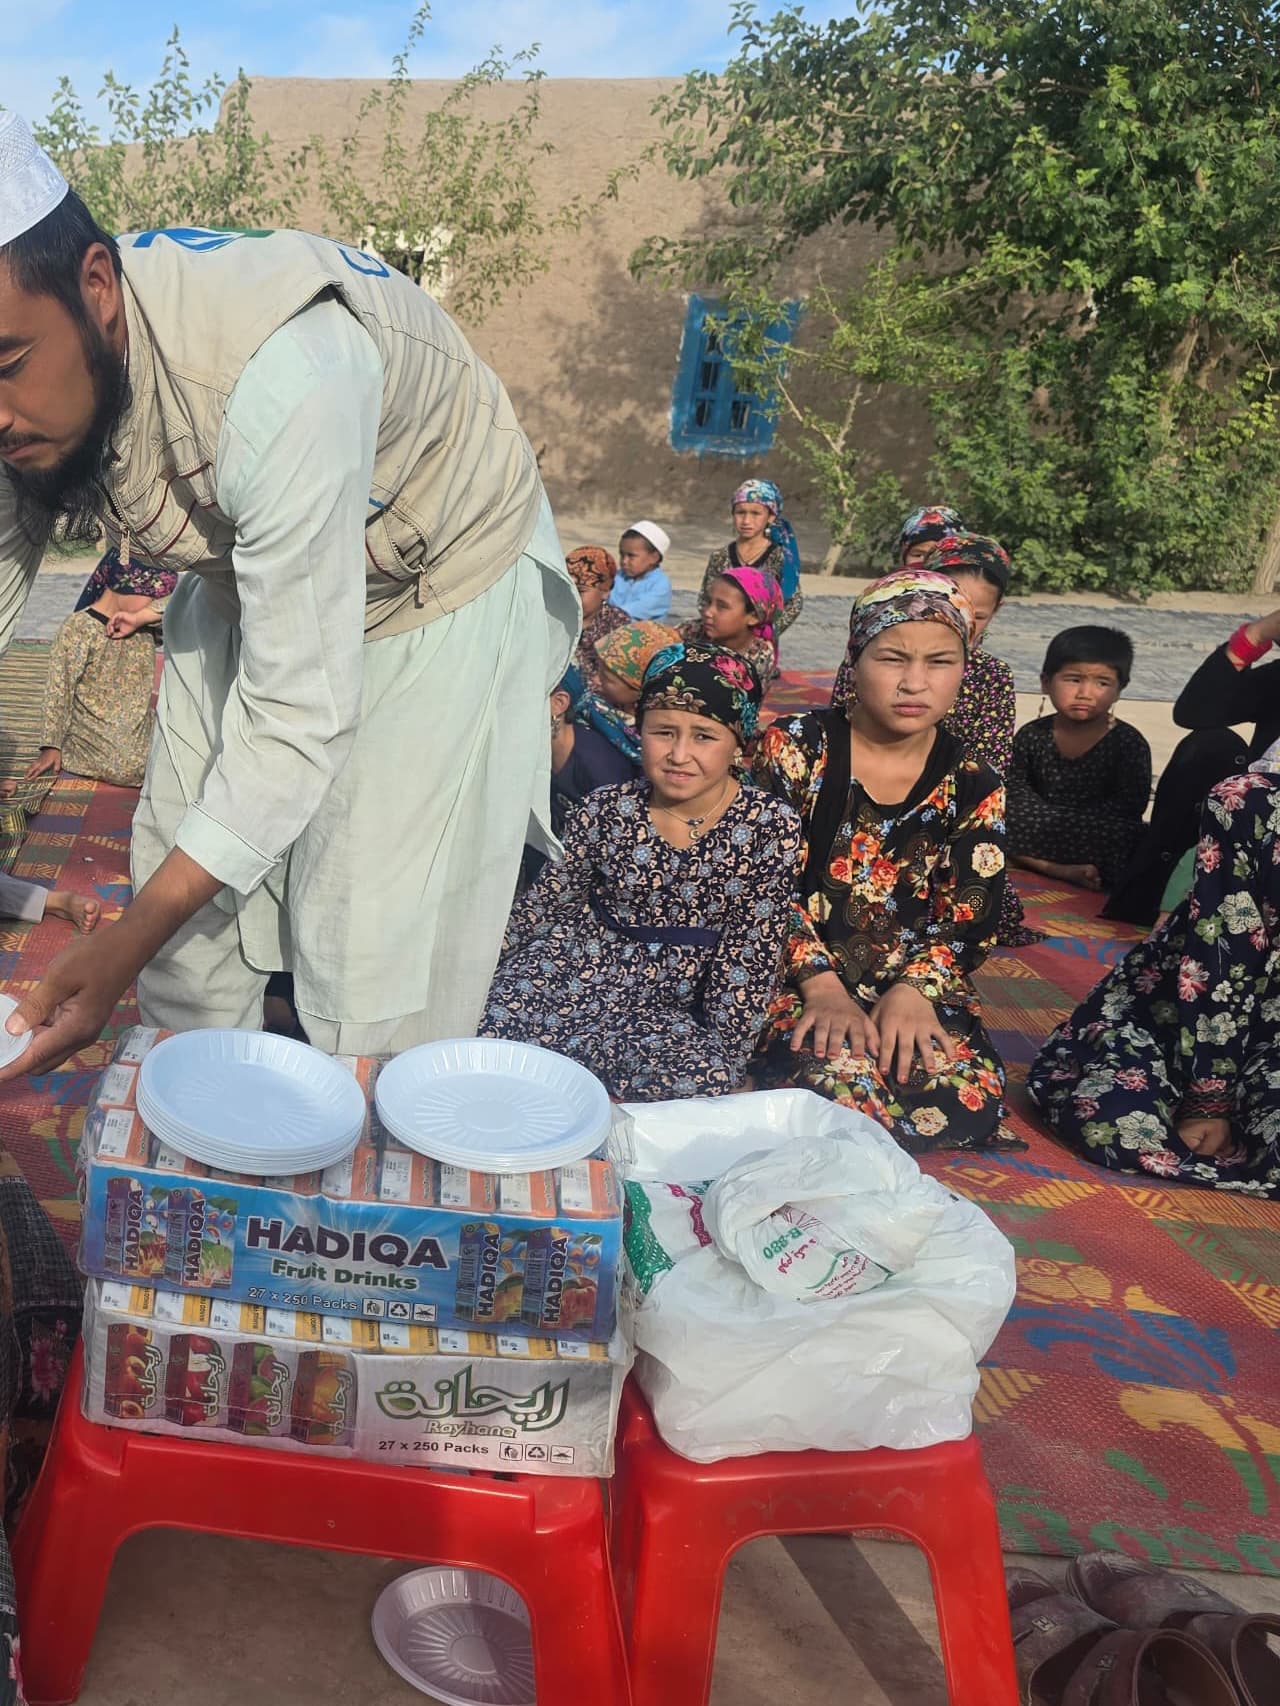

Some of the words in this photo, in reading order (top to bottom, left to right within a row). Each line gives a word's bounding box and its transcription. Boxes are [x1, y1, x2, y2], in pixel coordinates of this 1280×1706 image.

[124, 1187, 144, 1271] HADIQA
[185, 1199, 206, 1281] HADIQA
[246, 1216, 450, 1271] HADIQA
[248, 1287, 266, 1298] 27
[271, 1292, 279, 1300] x
[284, 1294, 308, 1305] 250
[313, 1296, 358, 1310] Packs
[272, 1259, 328, 1281] Fruit
[334, 1268, 418, 1290] Drinks
[477, 1232, 501, 1317] HADIQA
[544, 1237, 568, 1323] HADIQA
[378, 1440, 396, 1450] 27
[400, 1442, 409, 1450] x
[414, 1441, 439, 1452] 250
[444, 1443, 489, 1454] Packs
[424, 1420, 517, 1438] Rayhana
